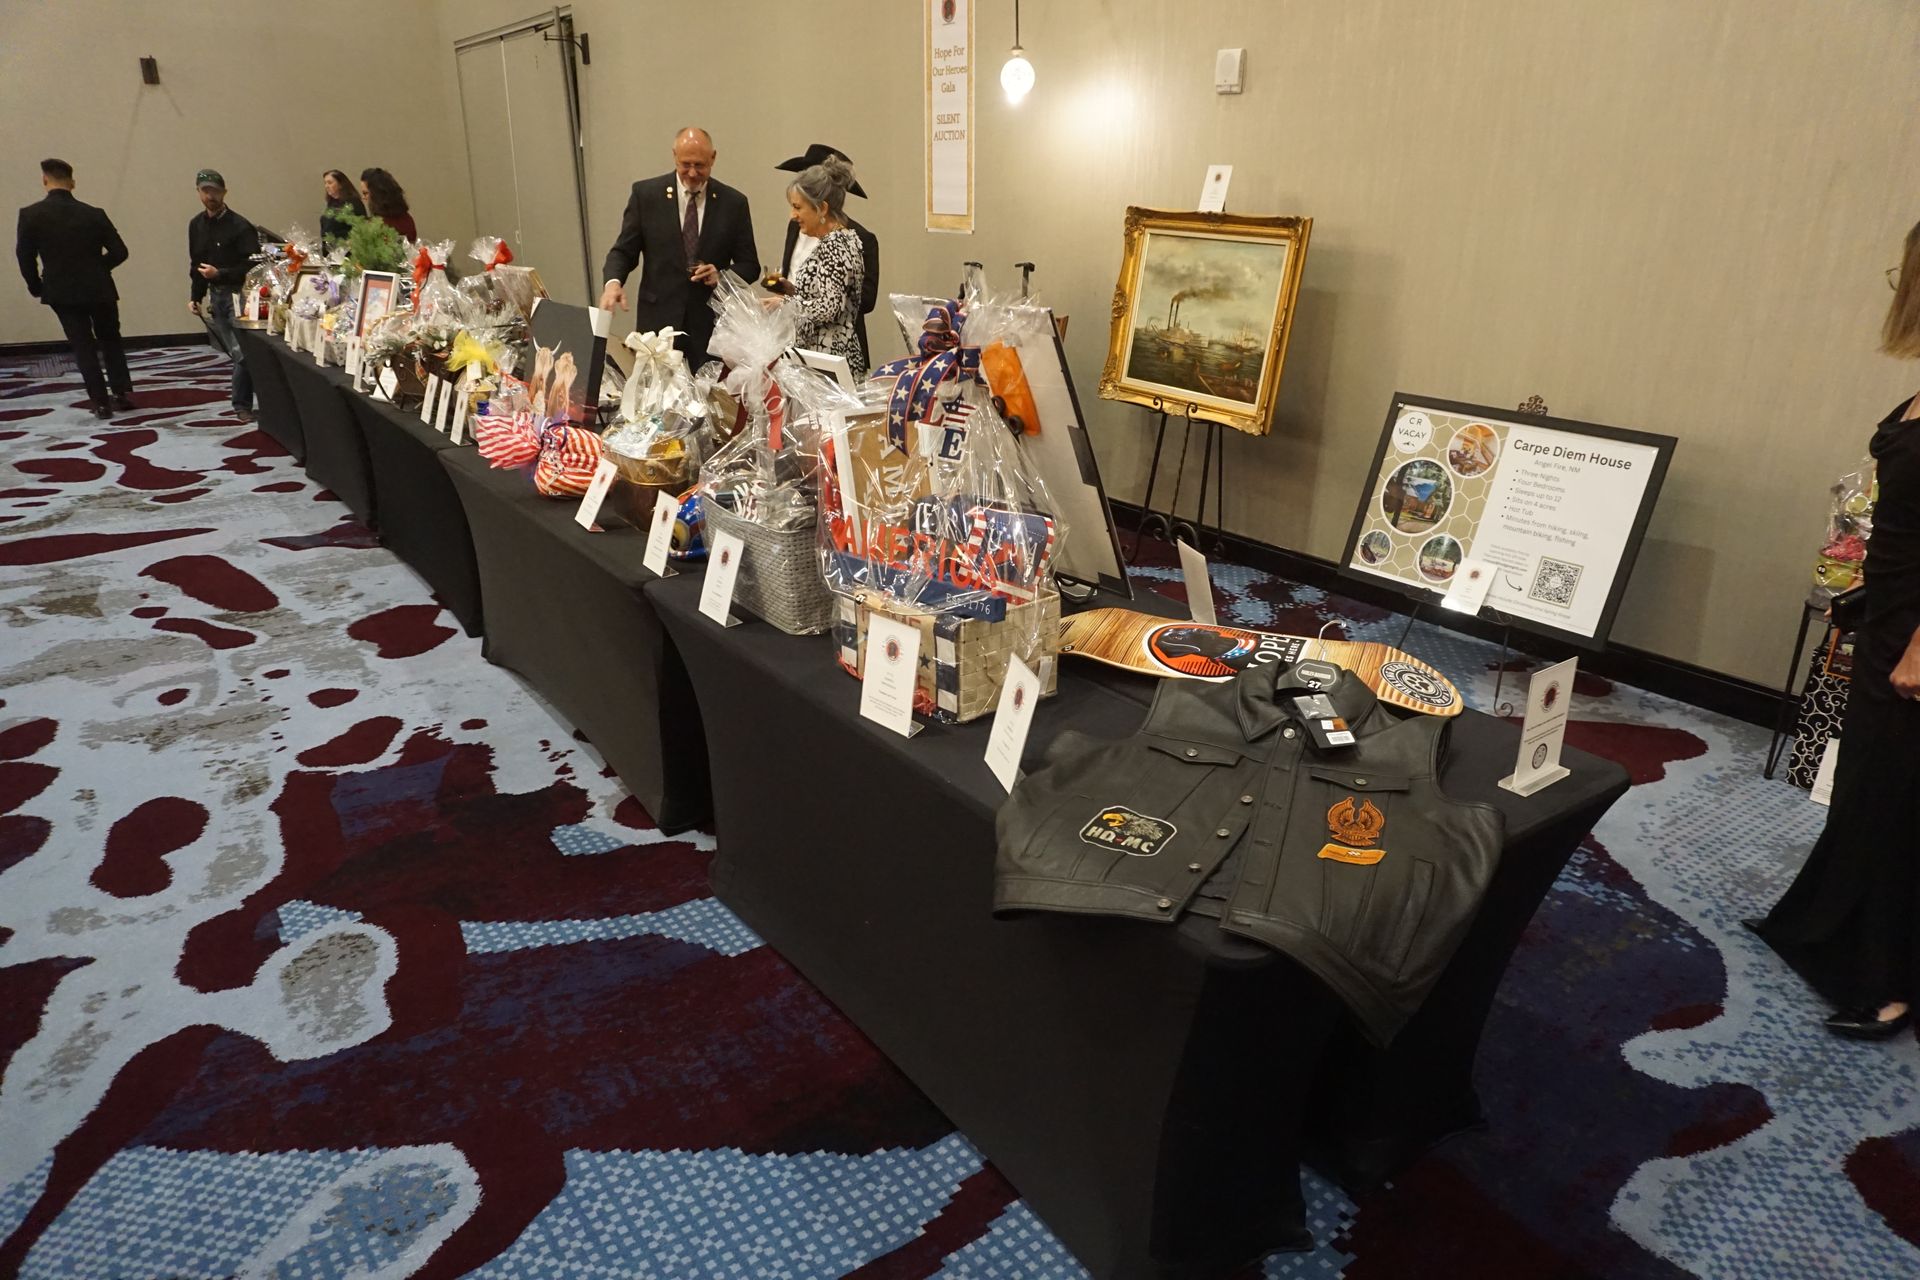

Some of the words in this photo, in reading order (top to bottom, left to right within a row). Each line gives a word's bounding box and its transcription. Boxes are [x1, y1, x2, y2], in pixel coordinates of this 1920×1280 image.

[934, 47, 952, 61] Hope
[953, 45, 965, 57] For
[932, 66, 945, 77] Our
[945, 64, 969, 76] Heroes
[941, 81, 956, 93] Gala
[936, 113, 961, 125] SILENT
[933, 129, 966, 141] AUCTION
[1398, 427, 1427, 439] VACAY
[1513, 439, 1550, 456] Carpe
[1552, 445, 1586, 462] Diem
[1589, 452, 1632, 470] House
[1534, 459, 1552, 469] Angel
[1568, 465, 1581, 473] NM
[1521, 469, 1539, 478] Three
[1539, 473, 1560, 482] Nights
[1533, 481, 1565, 493] Bedrooms
[1522, 508, 1534, 516] Tub
[1246, 634, 1291, 668] OPE
[1307, 680, 1322, 689] 27
